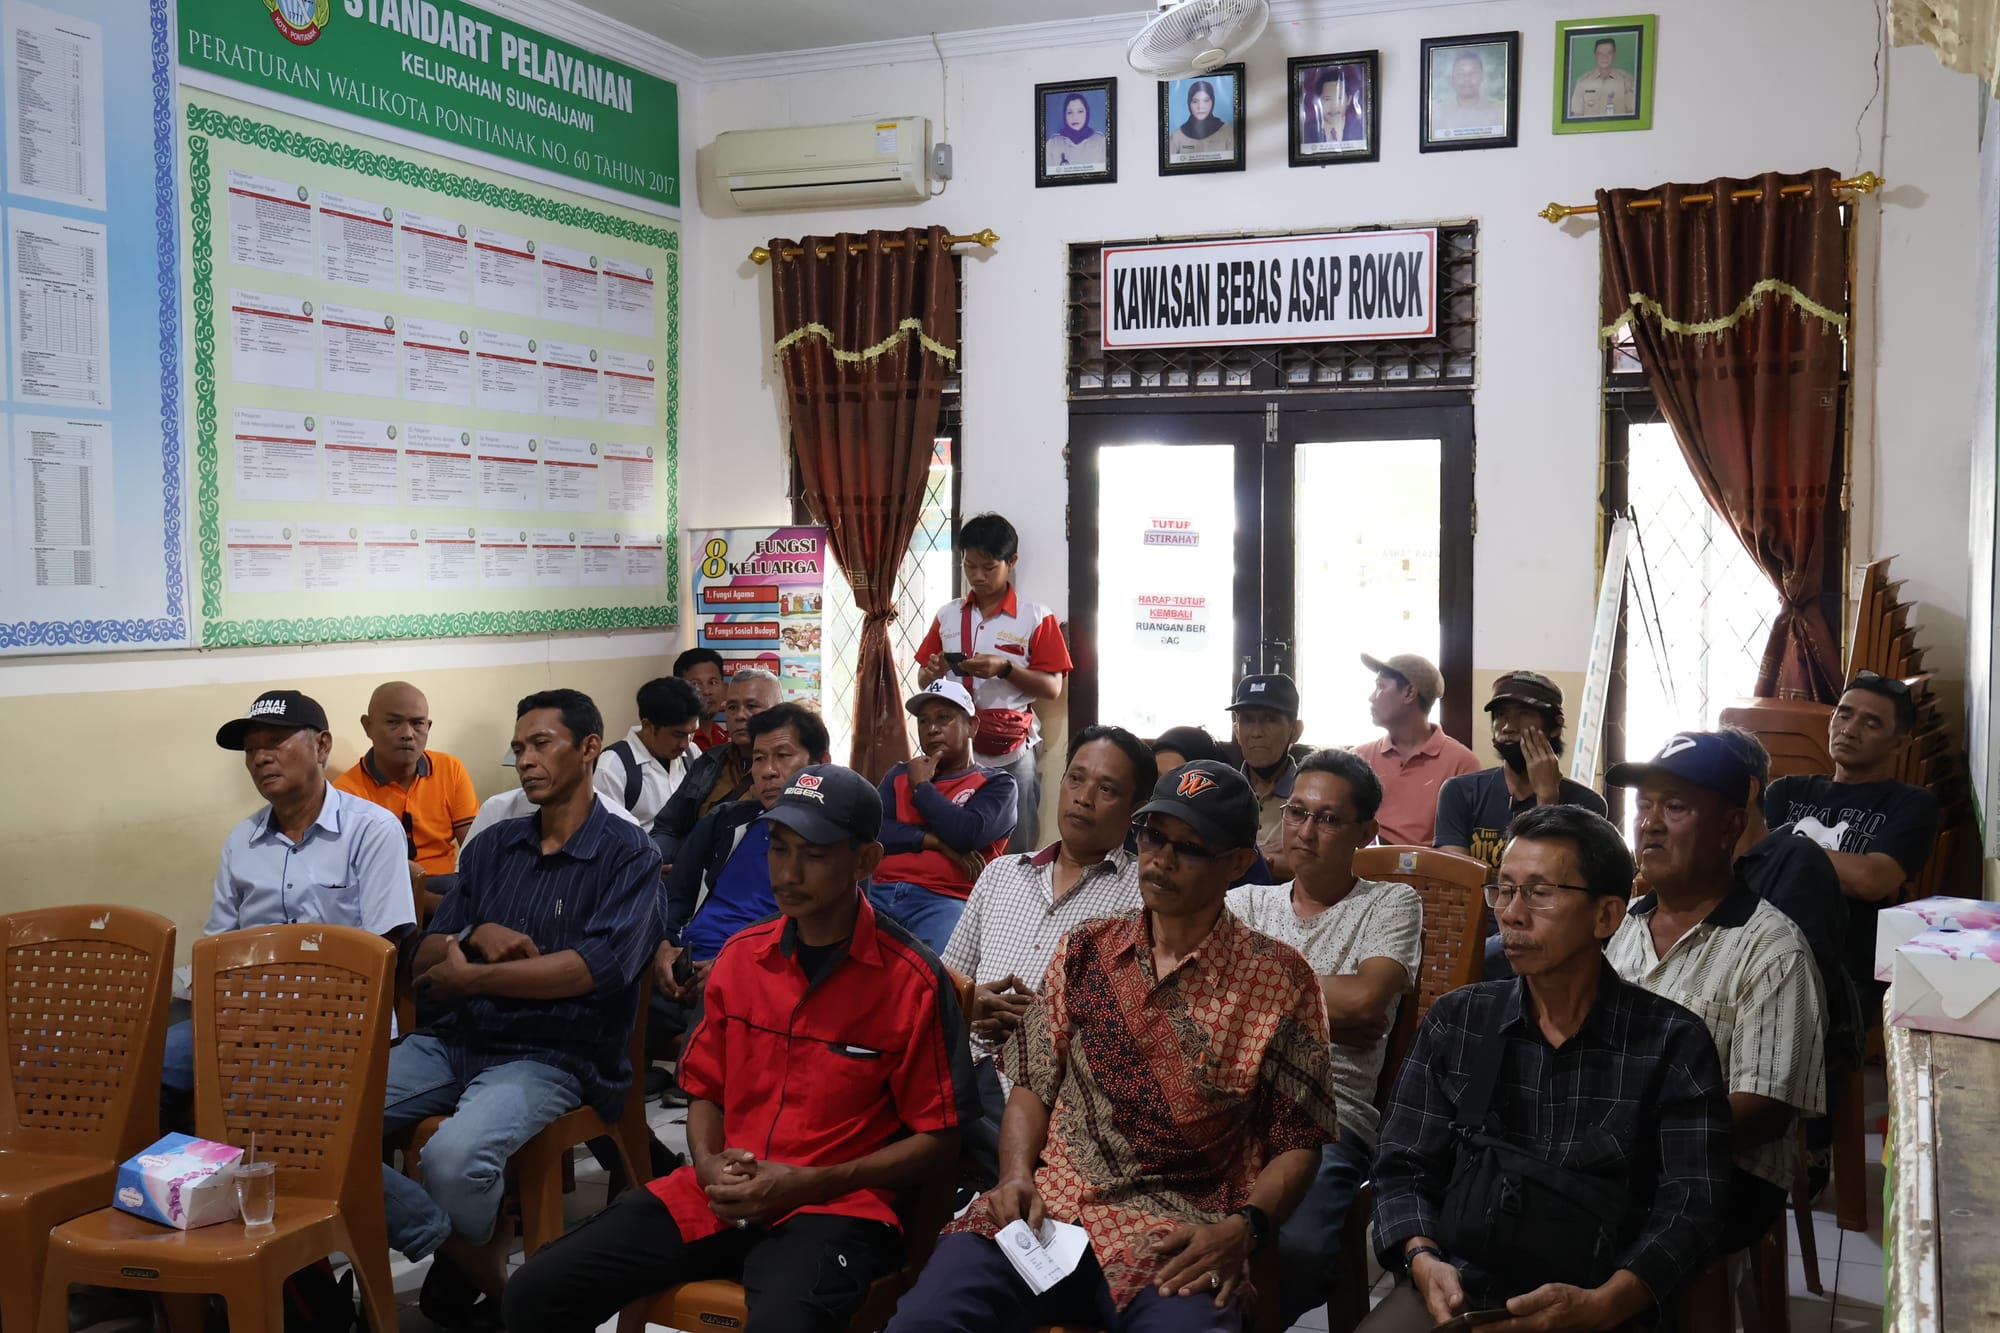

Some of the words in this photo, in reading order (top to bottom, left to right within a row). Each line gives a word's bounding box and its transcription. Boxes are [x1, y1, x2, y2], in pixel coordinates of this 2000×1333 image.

[275, 16, 288, 34] KOTA
[290, 28, 317, 42] PONTIANAK
[501, 31, 633, 114] PELAYANAN
[401, 50, 502, 103] KELURAHAN
[506, 86, 594, 133] SUNGAIJAWI
[188, 29, 320, 92] PERATURAN
[328, 72, 429, 124] WALIKOTA
[436, 105, 537, 157] PONTIANAK
[542, 139, 570, 166] NO.
[574, 151, 590, 171] 60
[594, 154, 645, 188] TAHUN
[649, 171, 675, 195] 2017
[1113, 263, 1210, 330] KAWASAN
[1217, 258, 1282, 326] BEBAS
[1288, 256, 1342, 323] ASAP
[1349, 251, 1423, 320] ROKOK
[1151, 519, 1192, 530] TUTUP
[1145, 533, 1198, 545] ISTIRAHAT
[702, 538, 728, 578] 8
[755, 539, 817, 555] FUNGSI
[728, 560, 818, 575] KELUARGA
[706, 591, 713, 599] 1.
[713, 591, 732, 600] Fungsi
[733, 591, 755, 600] Agama
[1138, 595, 1171, 605] HARAP
[1173, 596, 1206, 606] TUTUP
[1149, 608, 1193, 619] KEMBALI
[715, 628, 734, 636] Fungsi
[735, 627, 753, 635] Sosial
[754, 627, 776, 636] Budaya
[1135, 622, 1184, 632] RUANGAN
[1186, 624, 1206, 633] BER
